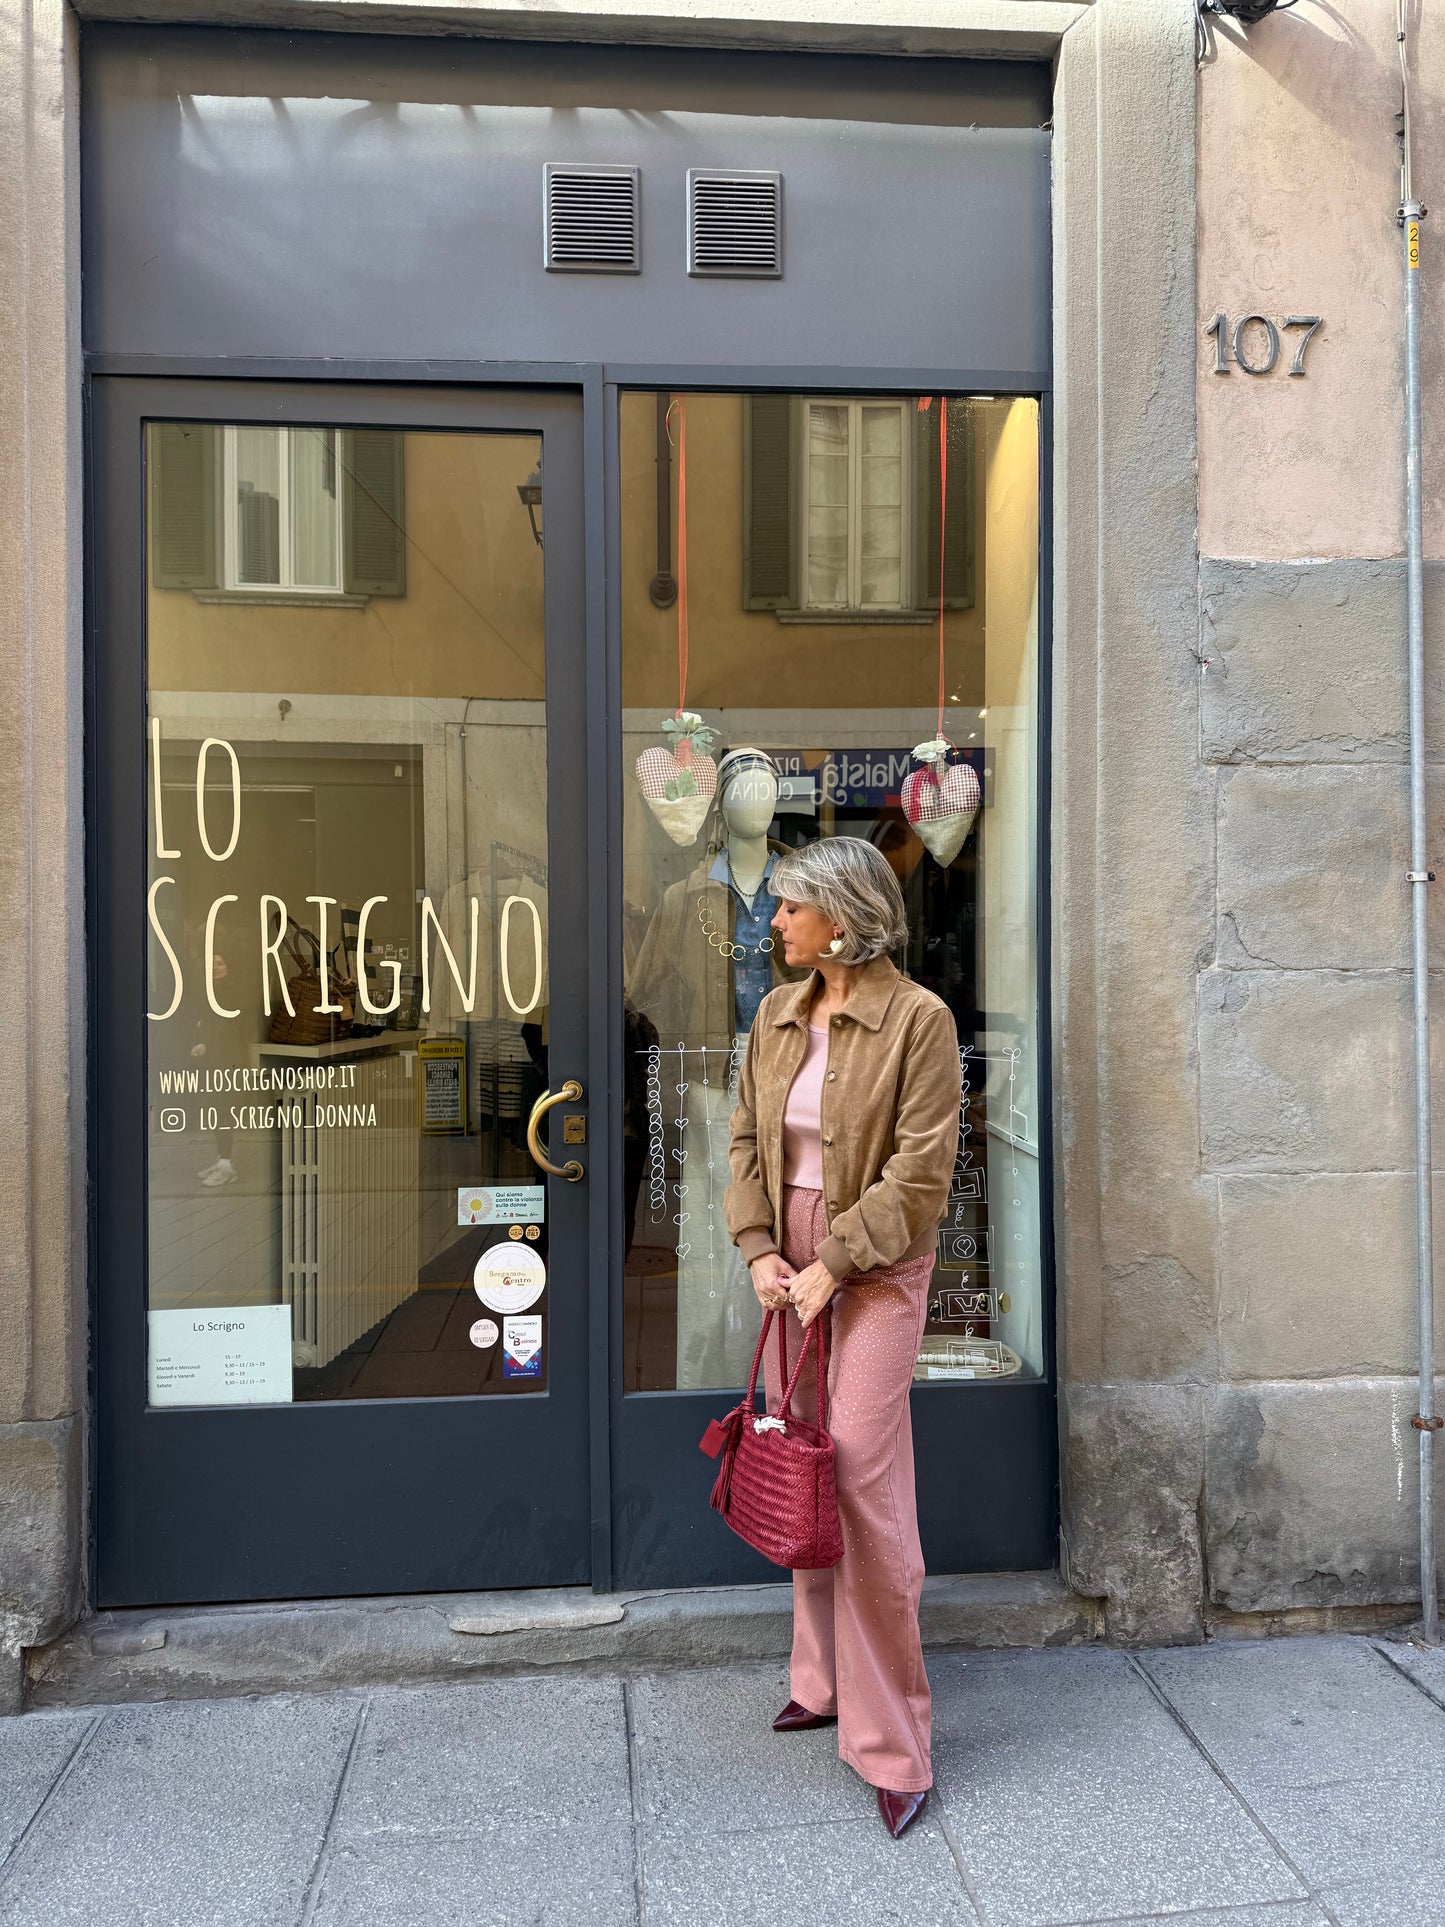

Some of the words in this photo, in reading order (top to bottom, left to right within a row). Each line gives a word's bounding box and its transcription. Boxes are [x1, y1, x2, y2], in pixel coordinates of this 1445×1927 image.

[1206, 313, 1323, 376] 107
[152, 716, 242, 862] LO
[146, 876, 543, 1020] SCRIGNO
[159, 1064, 357, 1095] WWW.LOSCRIGNOSHOP.IT
[199, 1102, 378, 1131] LO_SCRIGNO_DONNA
[489, 1270, 521, 1278] Bergamo
[193, 1322, 205, 1332] Lo
[208, 1321, 245, 1332] Scrigno
